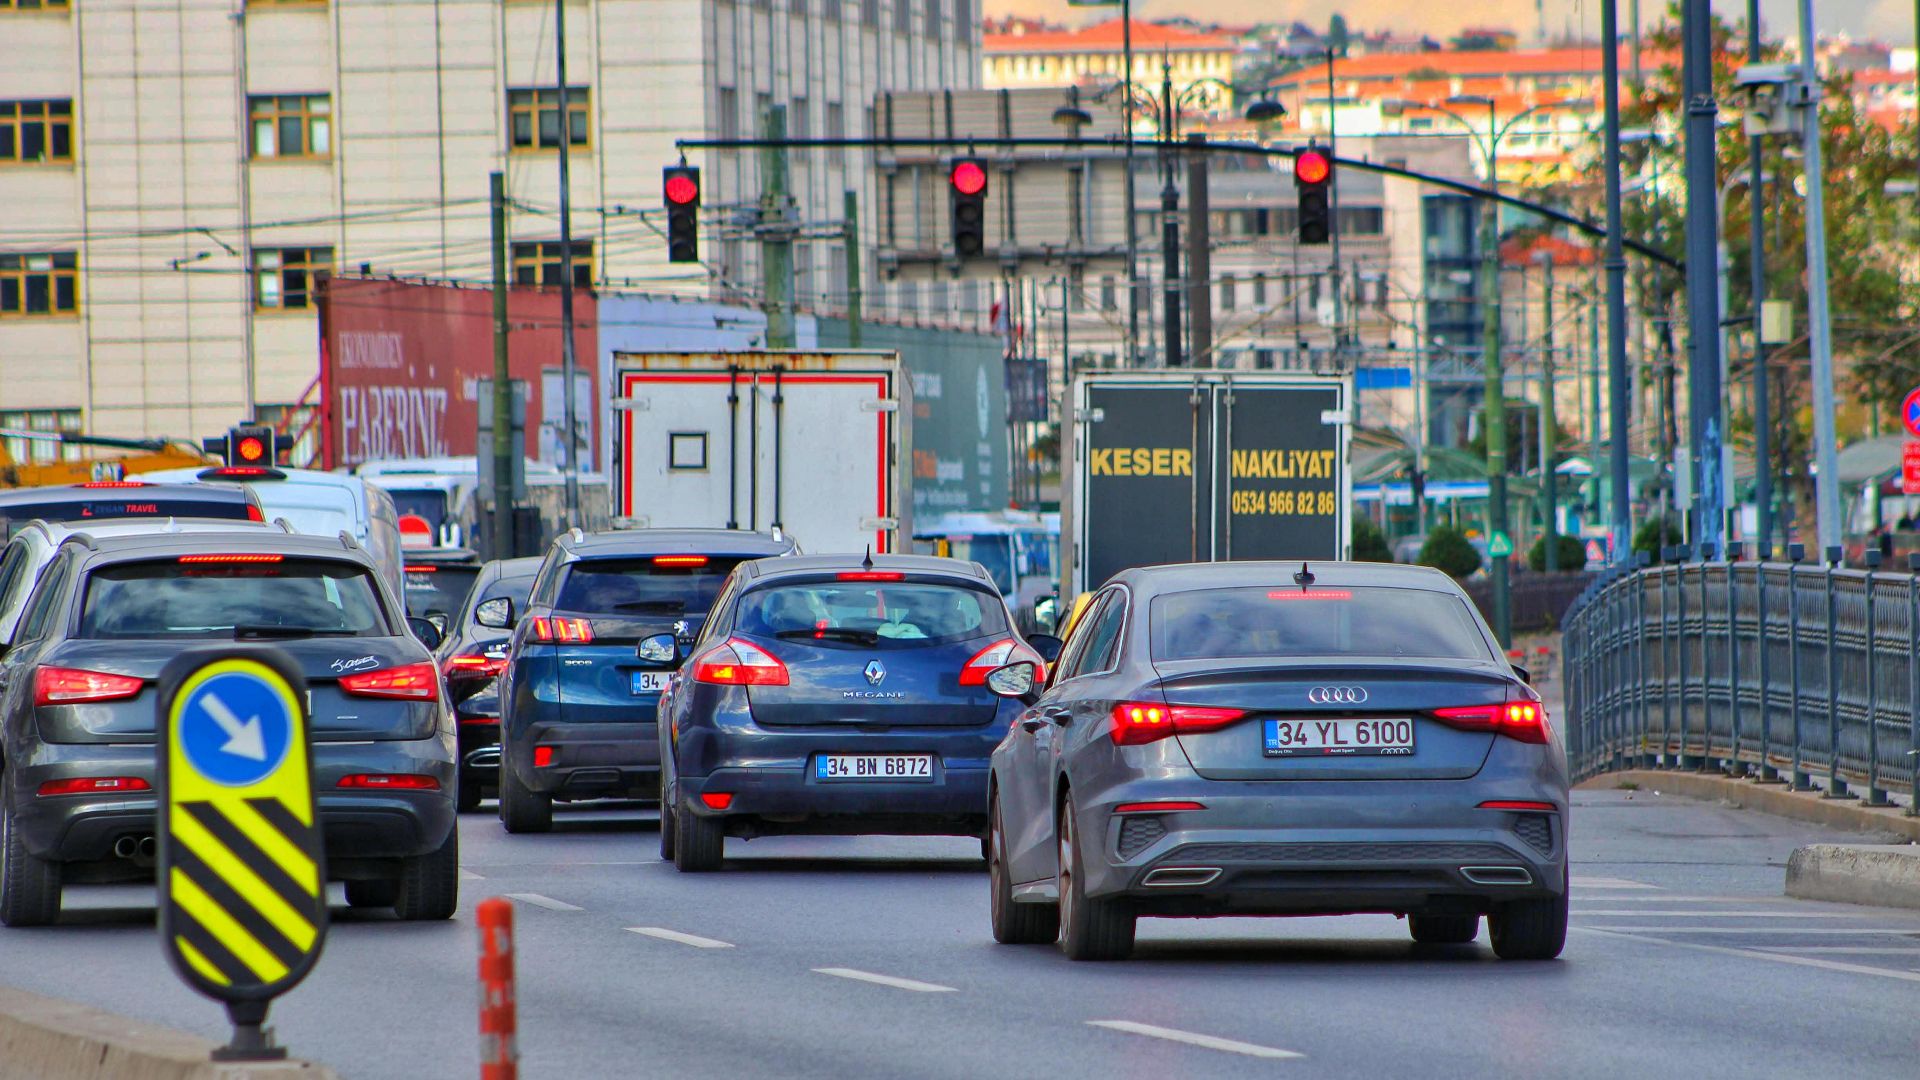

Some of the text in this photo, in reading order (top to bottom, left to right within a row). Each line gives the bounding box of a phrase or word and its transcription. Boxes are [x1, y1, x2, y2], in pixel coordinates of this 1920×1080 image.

[1091, 448, 1193, 476] KESER
[126, 503, 158, 513] TRAVEL
[1232, 490, 1335, 515] 0534 966 82 86
[642, 674, 659, 688] 34
[843, 691, 906, 699] MEGANE
[1279, 721, 1410, 746] 34 YL 6100
[1267, 738, 1278, 746] TR
[828, 757, 928, 775] 34 BN 6872
